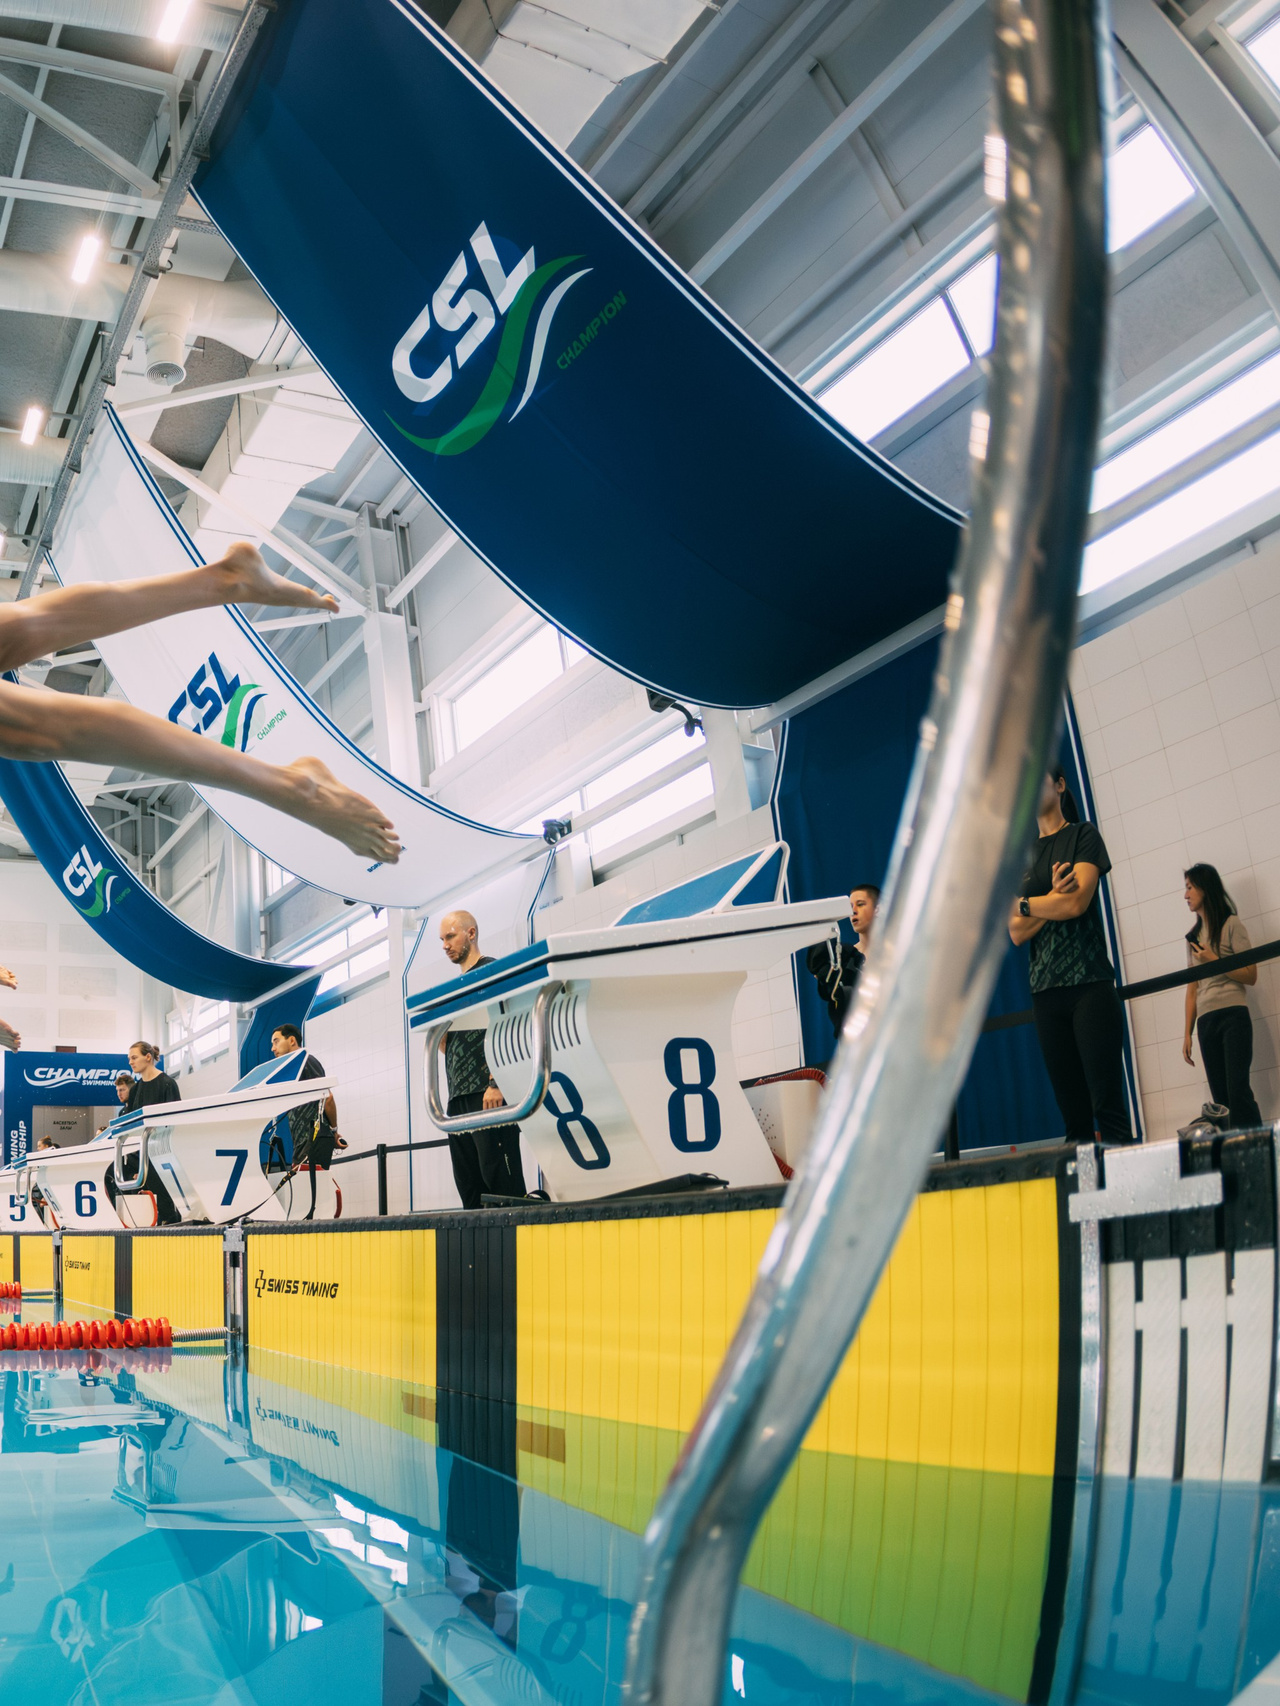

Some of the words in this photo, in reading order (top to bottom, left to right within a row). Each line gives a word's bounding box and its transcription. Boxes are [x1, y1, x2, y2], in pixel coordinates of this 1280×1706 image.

[392, 220, 536, 403] CSL
[63, 844, 103, 897] CSL
[663, 1037, 721, 1154] 8
[74, 1180, 97, 1217] 6
[215, 1149, 248, 1206] 7
[9, 1195, 26, 1221] 5
[266, 1278, 300, 1295] SWISS
[301, 1280, 339, 1299] TIMING
